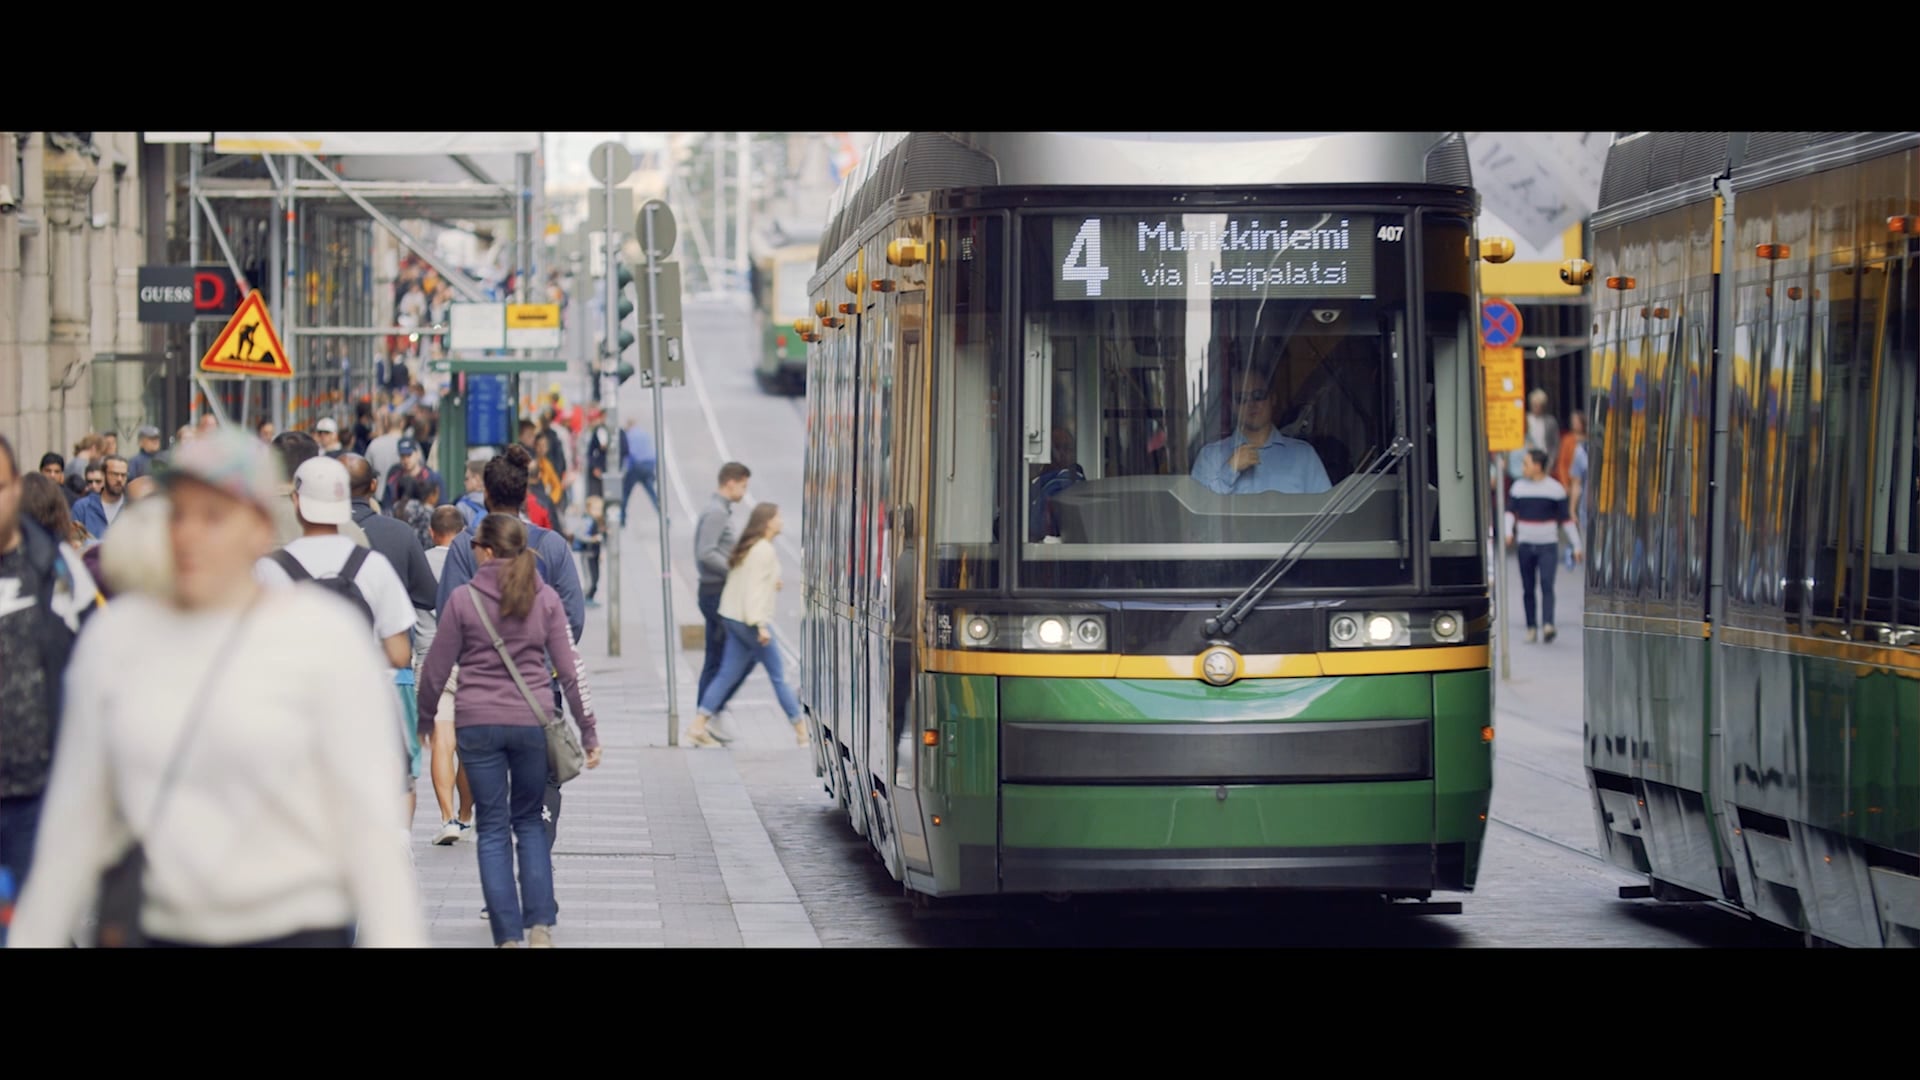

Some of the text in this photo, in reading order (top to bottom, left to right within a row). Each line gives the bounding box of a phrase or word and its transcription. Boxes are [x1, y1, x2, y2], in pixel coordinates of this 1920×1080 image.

[1137, 219, 1350, 251] Munkkiniemi
[1377, 225, 1404, 242] 407
[1062, 218, 1109, 296] 4
[1141, 260, 1348, 291] via Lasipalatsi
[140, 285, 193, 303] GUESS
